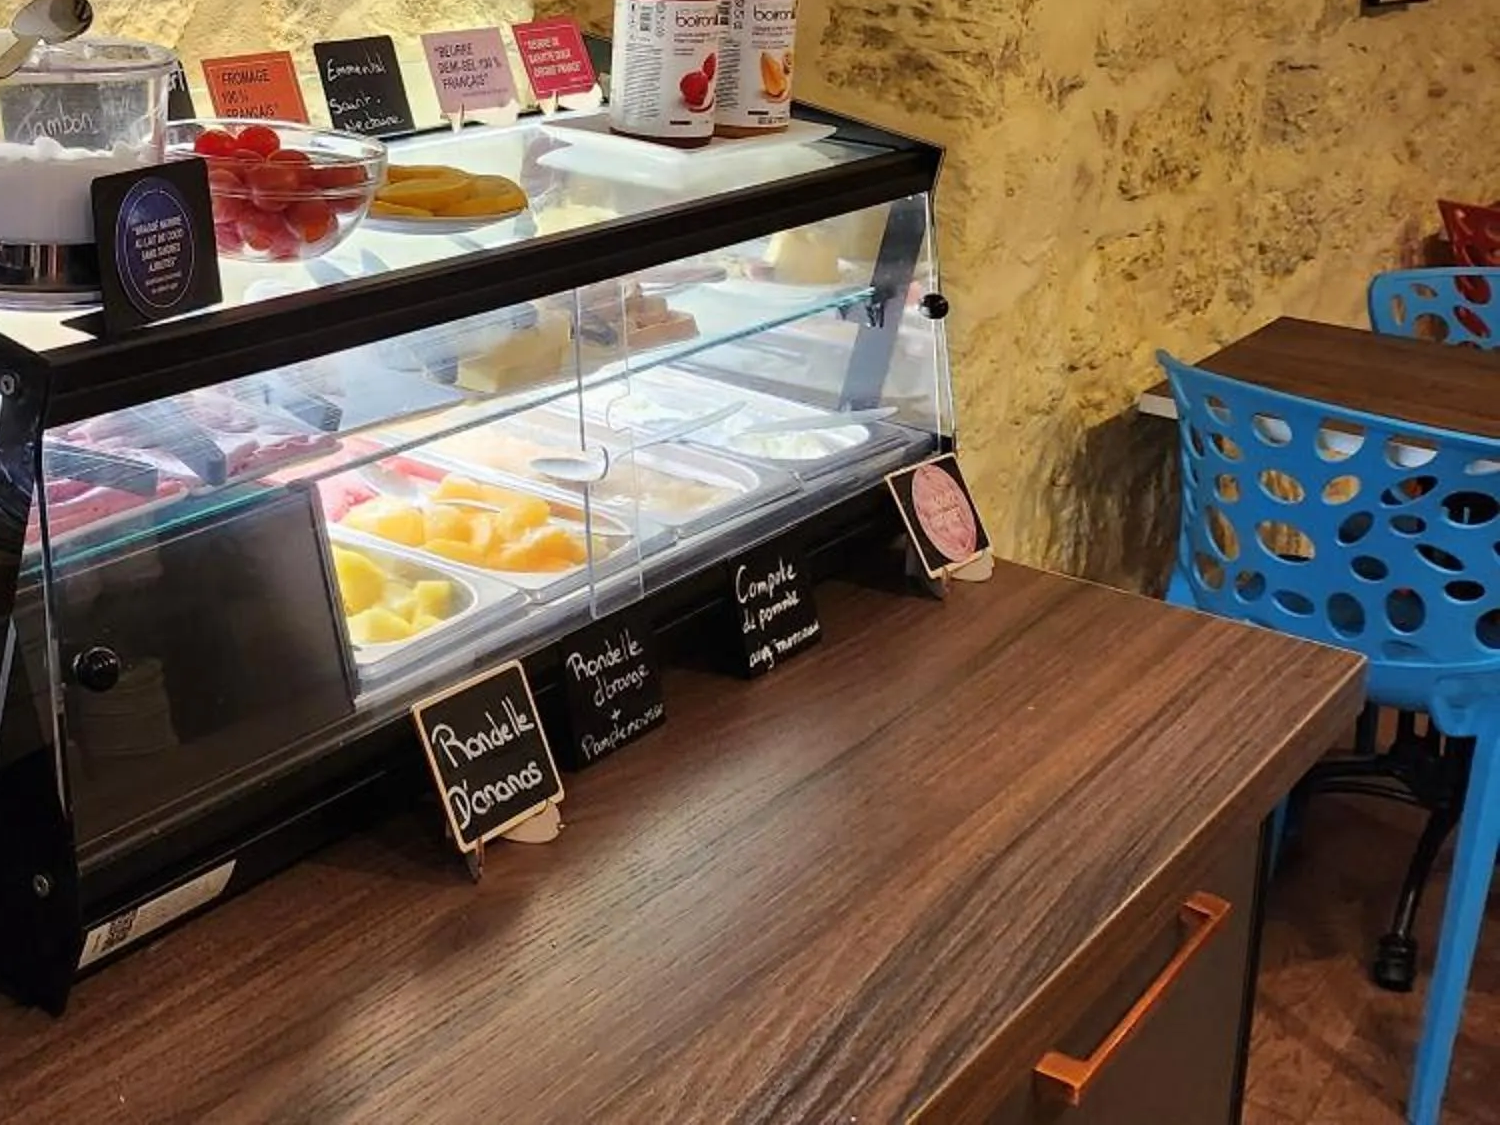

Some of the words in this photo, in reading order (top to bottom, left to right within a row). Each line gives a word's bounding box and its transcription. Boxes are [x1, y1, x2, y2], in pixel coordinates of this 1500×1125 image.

[566, 629, 644, 681] Rondelle
[431, 695, 535, 769] Rondelle
[446, 760, 544, 831] D'ananas
